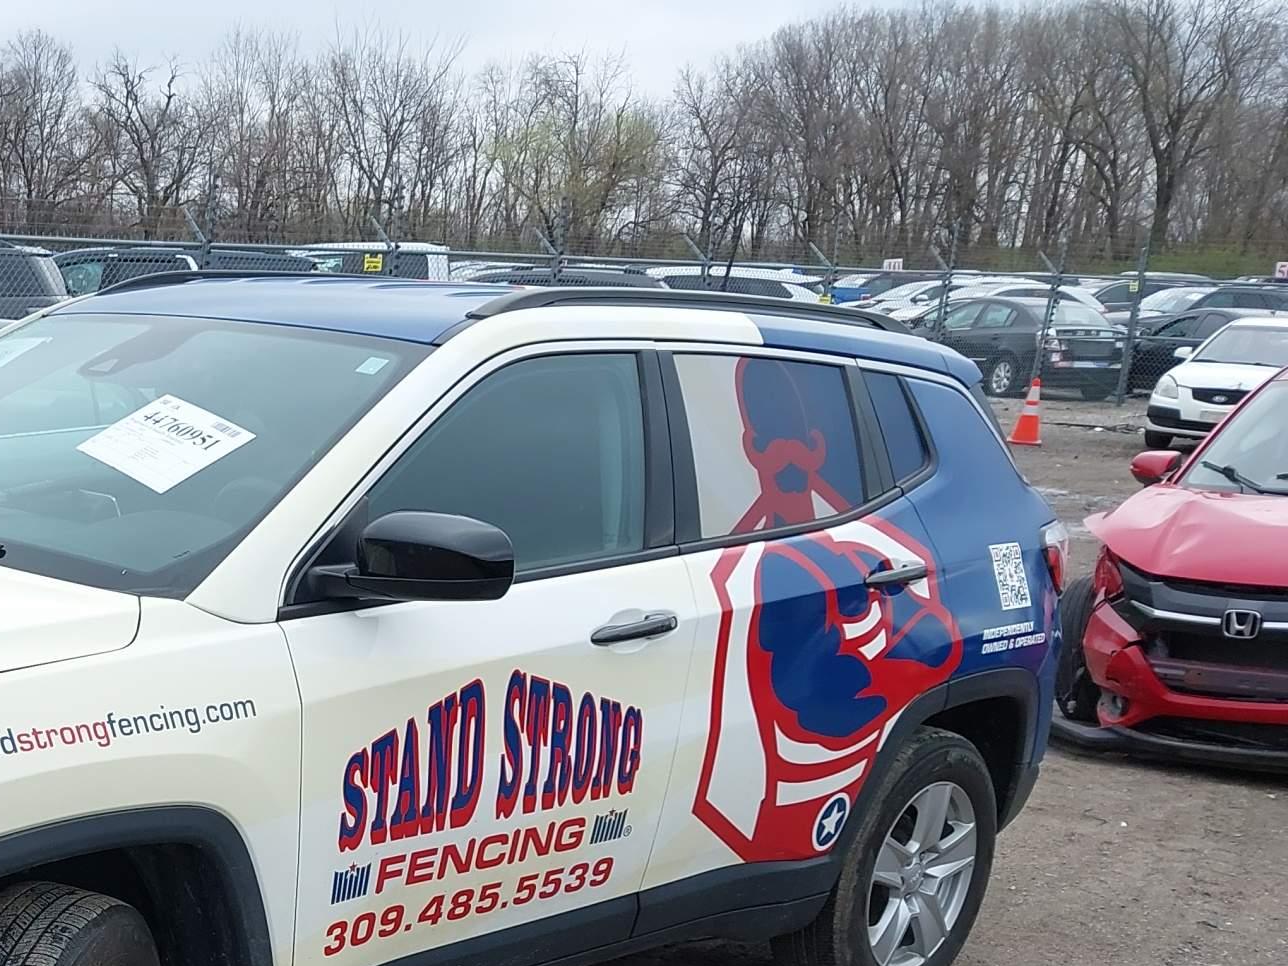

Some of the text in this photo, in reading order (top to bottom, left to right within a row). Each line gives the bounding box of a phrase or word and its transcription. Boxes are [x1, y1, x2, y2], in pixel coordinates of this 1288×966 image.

[143, 410, 222, 452] 44760951
[981, 640, 1009, 655] OWNED
[1014, 632, 1046, 648] OPERATED
[983, 621, 1034, 640] INDEPENDENTLY
[338, 668, 643, 853] STAND STRONG
[374, 817, 587, 895] FENCING
[323, 856, 615, 957] 309.485.5539
